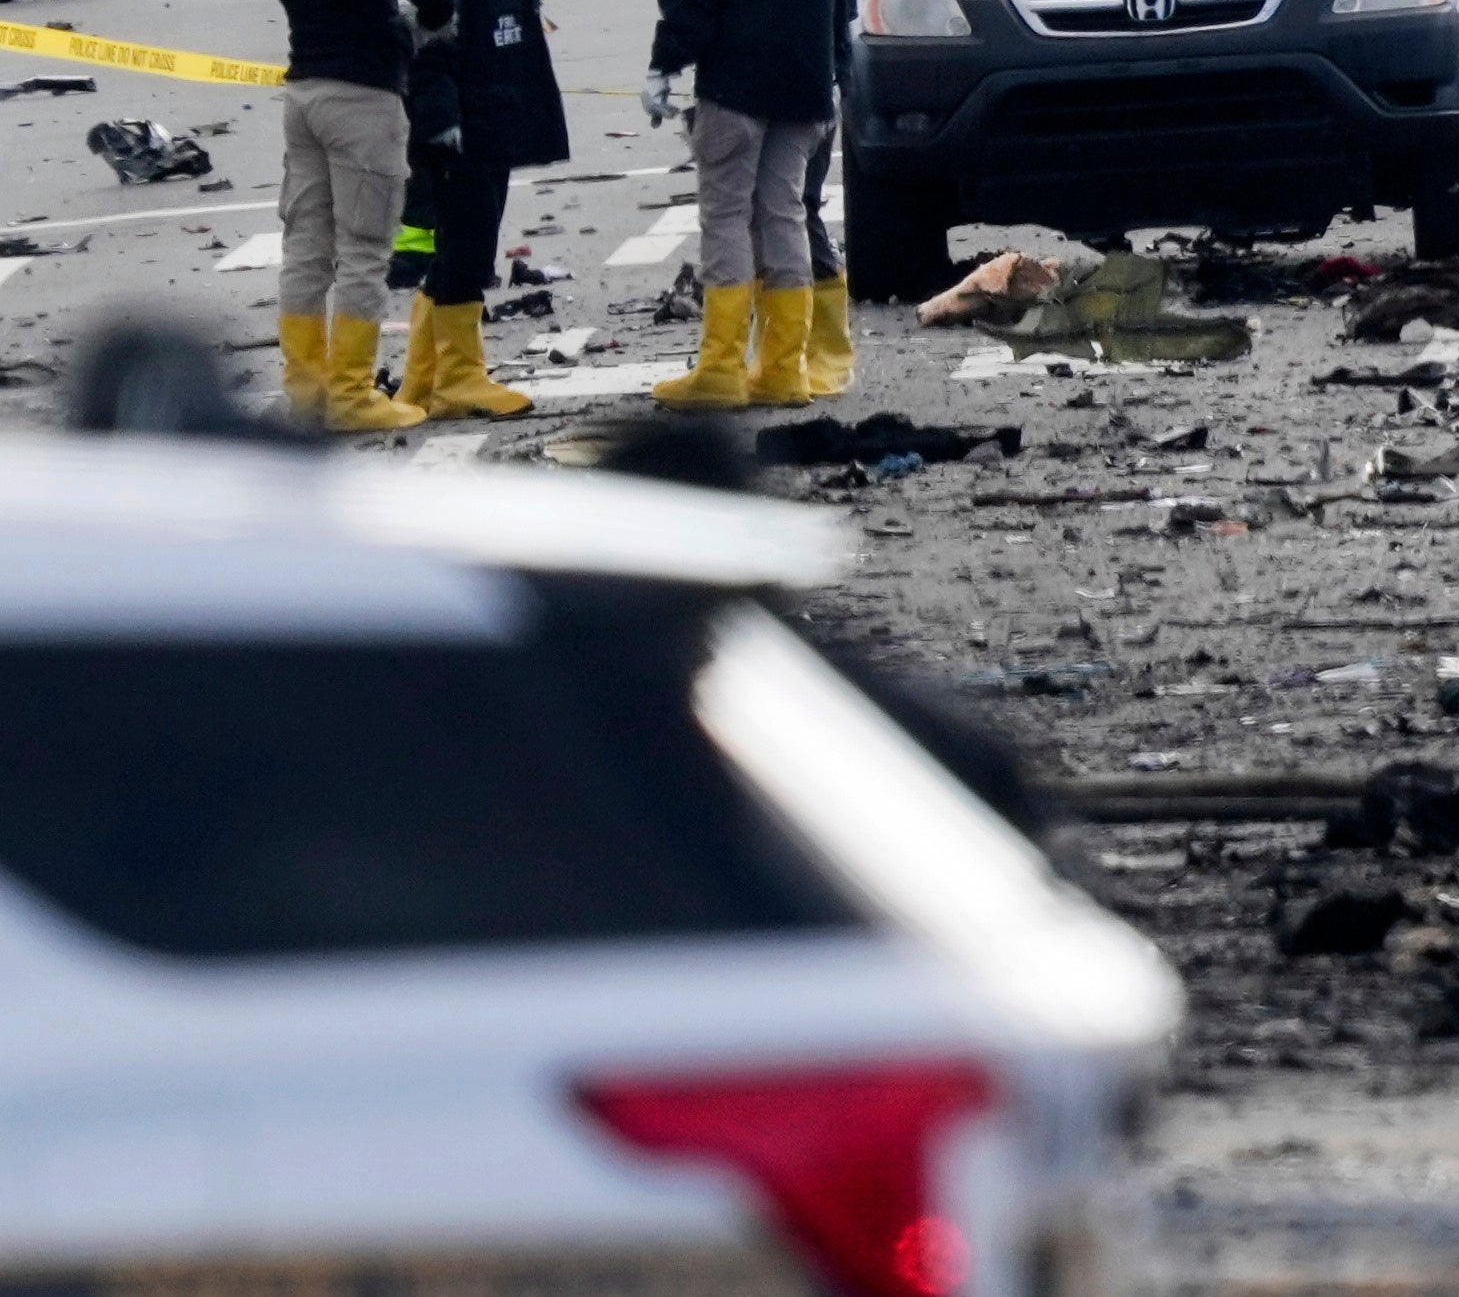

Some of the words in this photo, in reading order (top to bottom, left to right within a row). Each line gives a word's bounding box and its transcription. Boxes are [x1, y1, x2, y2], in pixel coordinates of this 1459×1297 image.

[71, 37, 98, 59] POLICE
[100, 43, 117, 62] LINE
[117, 45, 129, 64] DO
[132, 49, 148, 67] NOT
[149, 52, 175, 72] CROSS
